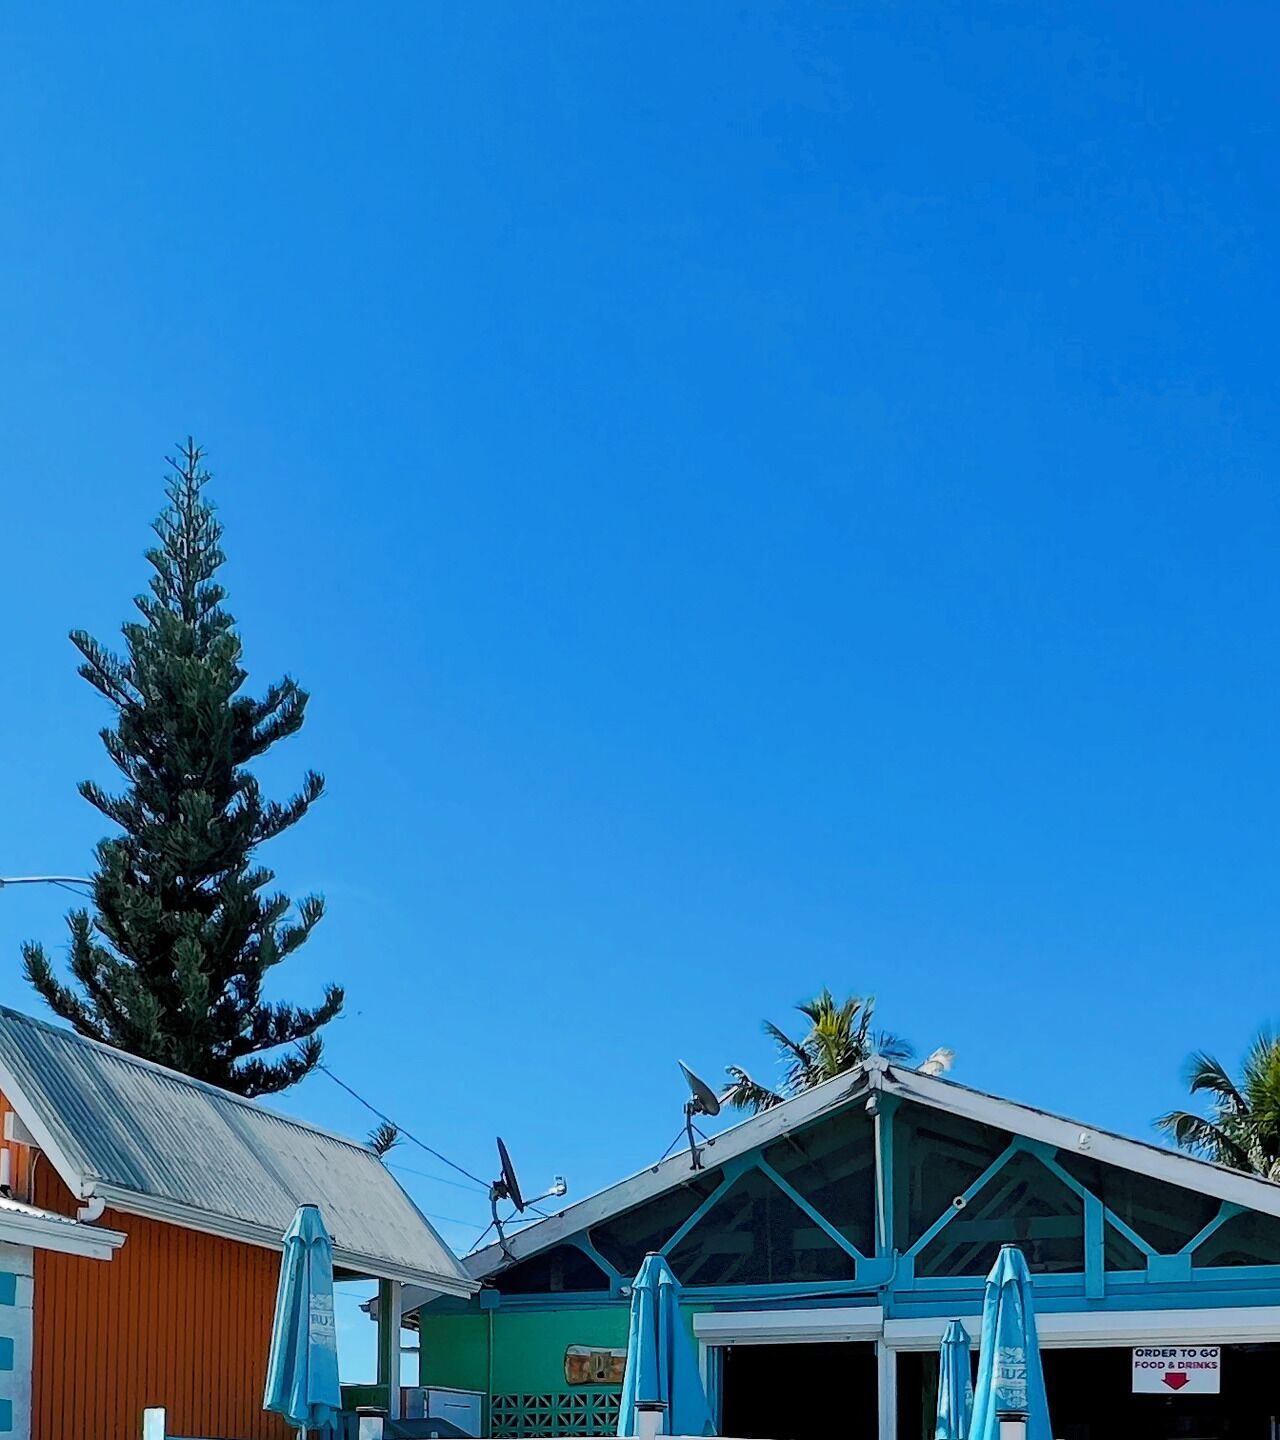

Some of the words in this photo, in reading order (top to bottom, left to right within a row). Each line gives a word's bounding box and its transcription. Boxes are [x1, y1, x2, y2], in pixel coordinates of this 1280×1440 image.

[1135, 1348, 1177, 1358] ORDER
[1180, 1348, 1197, 1358] TO
[1200, 1348, 1218, 1358] GO
[1135, 1361, 1165, 1369] FOOD
[1168, 1361, 1175, 1369] &
[1178, 1361, 1218, 1369] DRINKS
